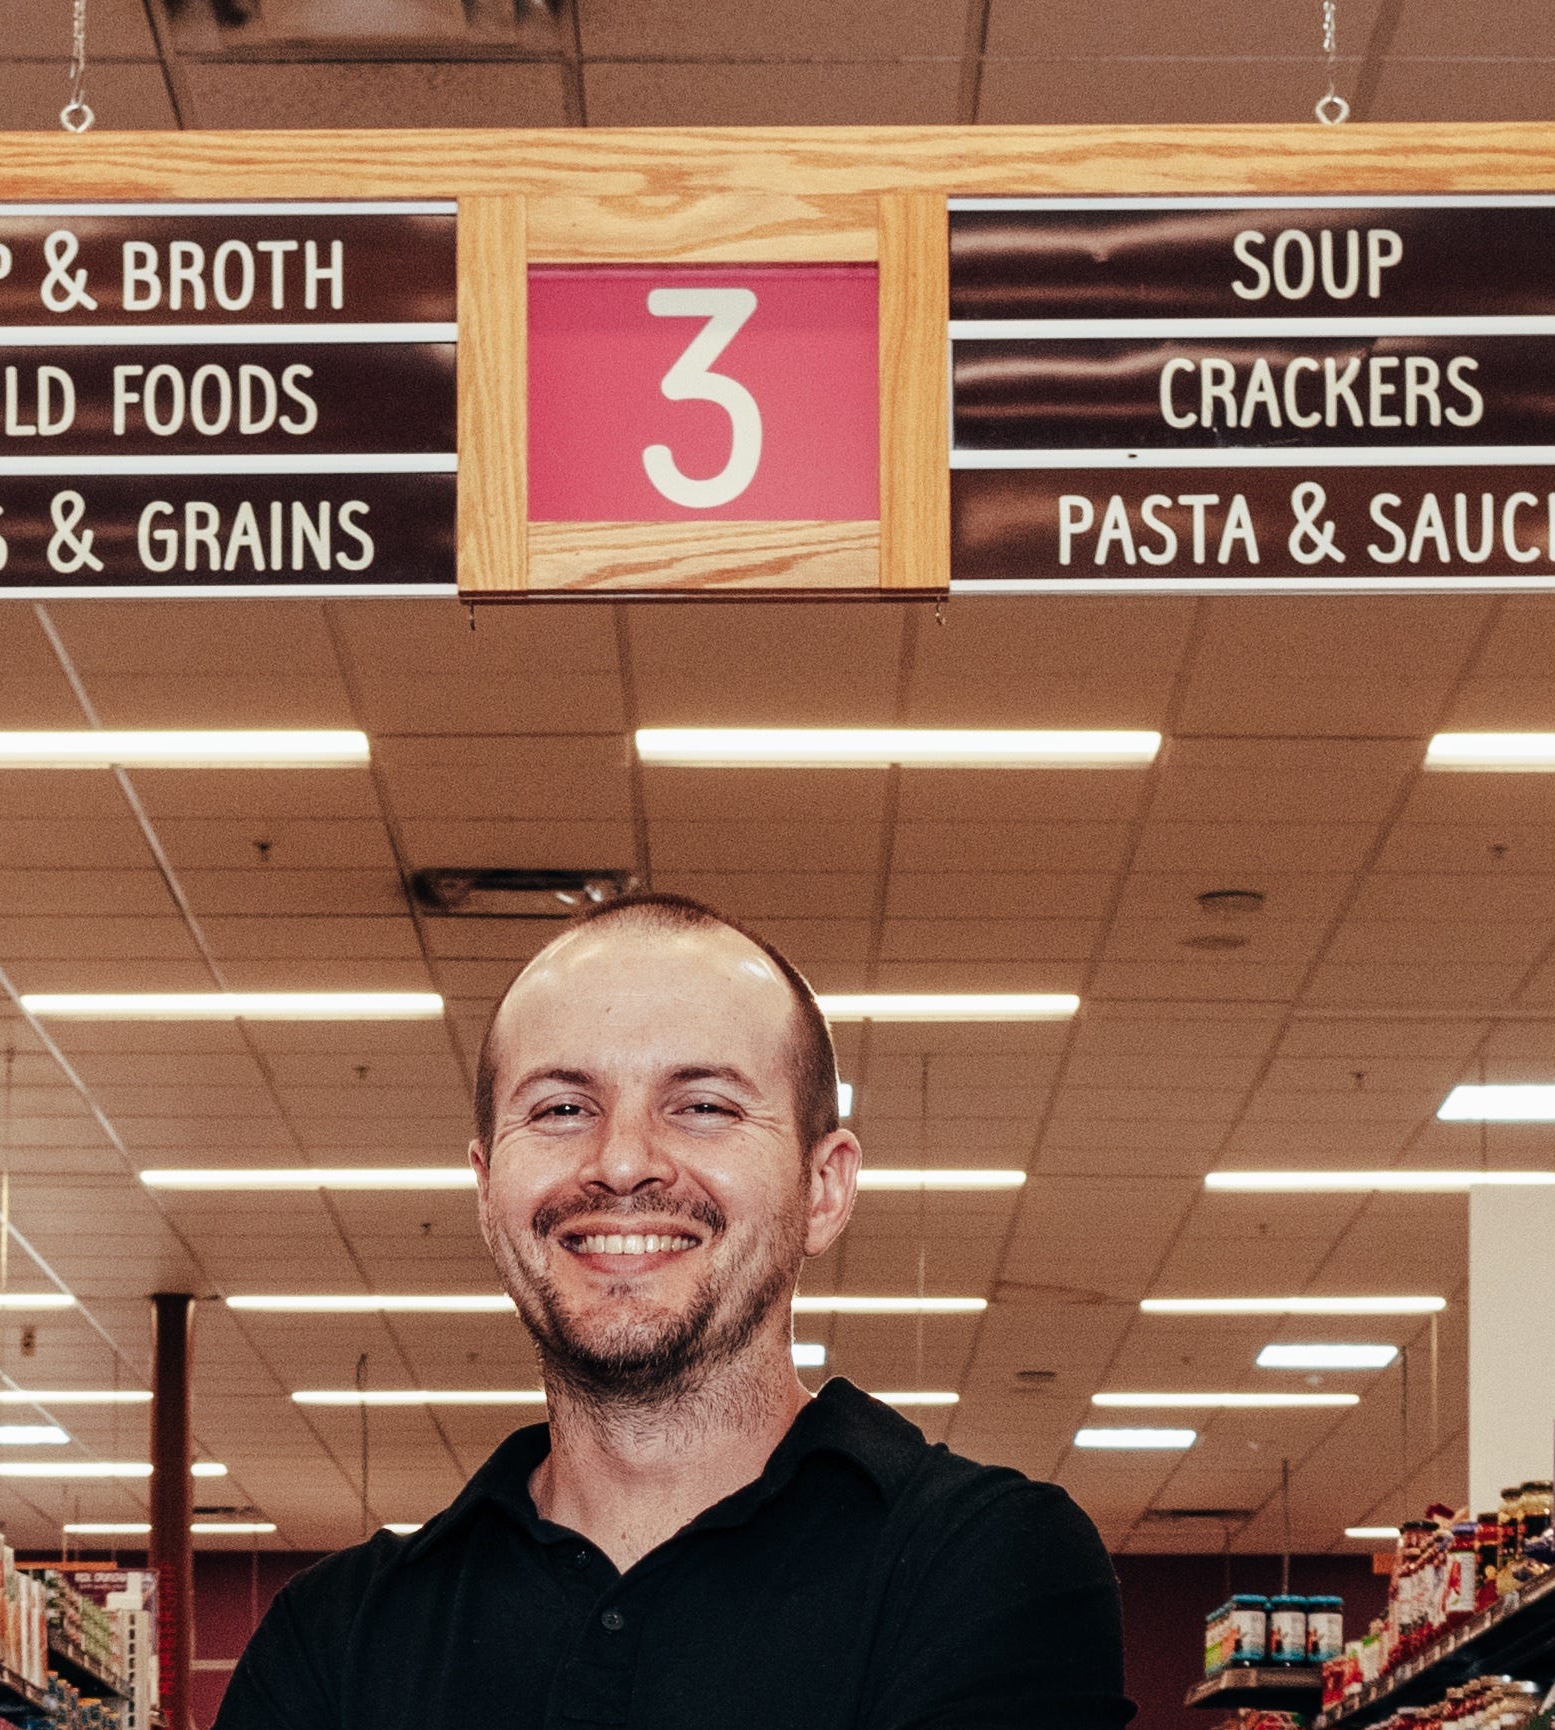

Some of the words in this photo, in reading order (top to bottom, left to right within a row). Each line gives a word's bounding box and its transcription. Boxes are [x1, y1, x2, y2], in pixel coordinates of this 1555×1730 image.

[41, 229, 97, 312] &
[123, 240, 342, 310] BROTH
[1233, 230, 1402, 299] SOUP
[114, 365, 317, 435] FOODS
[642, 288, 764, 509] 3
[1161, 357, 1482, 428] CRACKERS
[48, 491, 103, 573] &
[138, 501, 373, 571] GRAINS
[1059, 494, 1259, 565] PASTA
[1289, 482, 1345, 564] &
